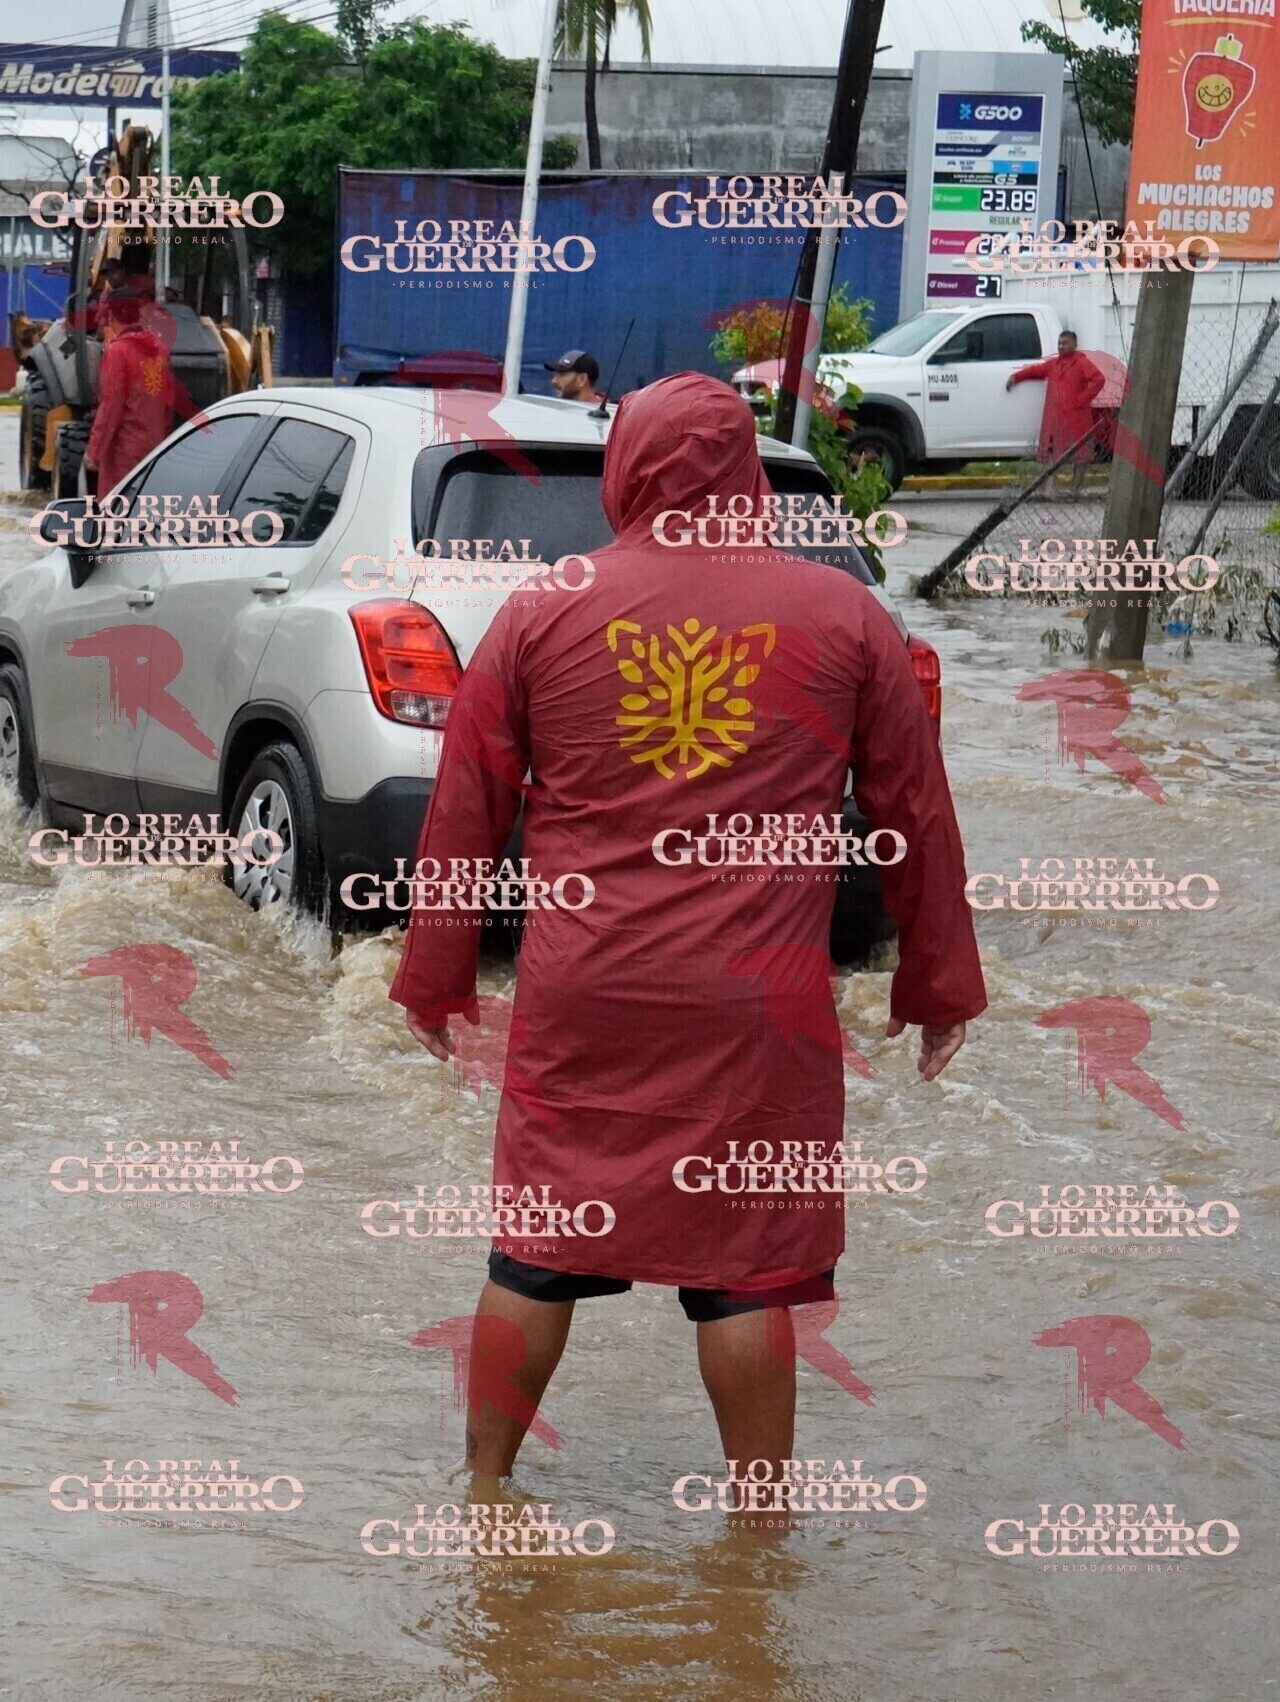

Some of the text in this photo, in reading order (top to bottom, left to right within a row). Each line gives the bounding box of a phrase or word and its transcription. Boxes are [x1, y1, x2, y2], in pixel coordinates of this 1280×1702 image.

[1195, 165, 1222, 181] LOS
[980, 189, 1036, 211] 23.89
[1137, 183, 1275, 209] MUCHACHOS
[1156, 208, 1251, 234] ALEGRES
[975, 276, 1001, 297] 27
